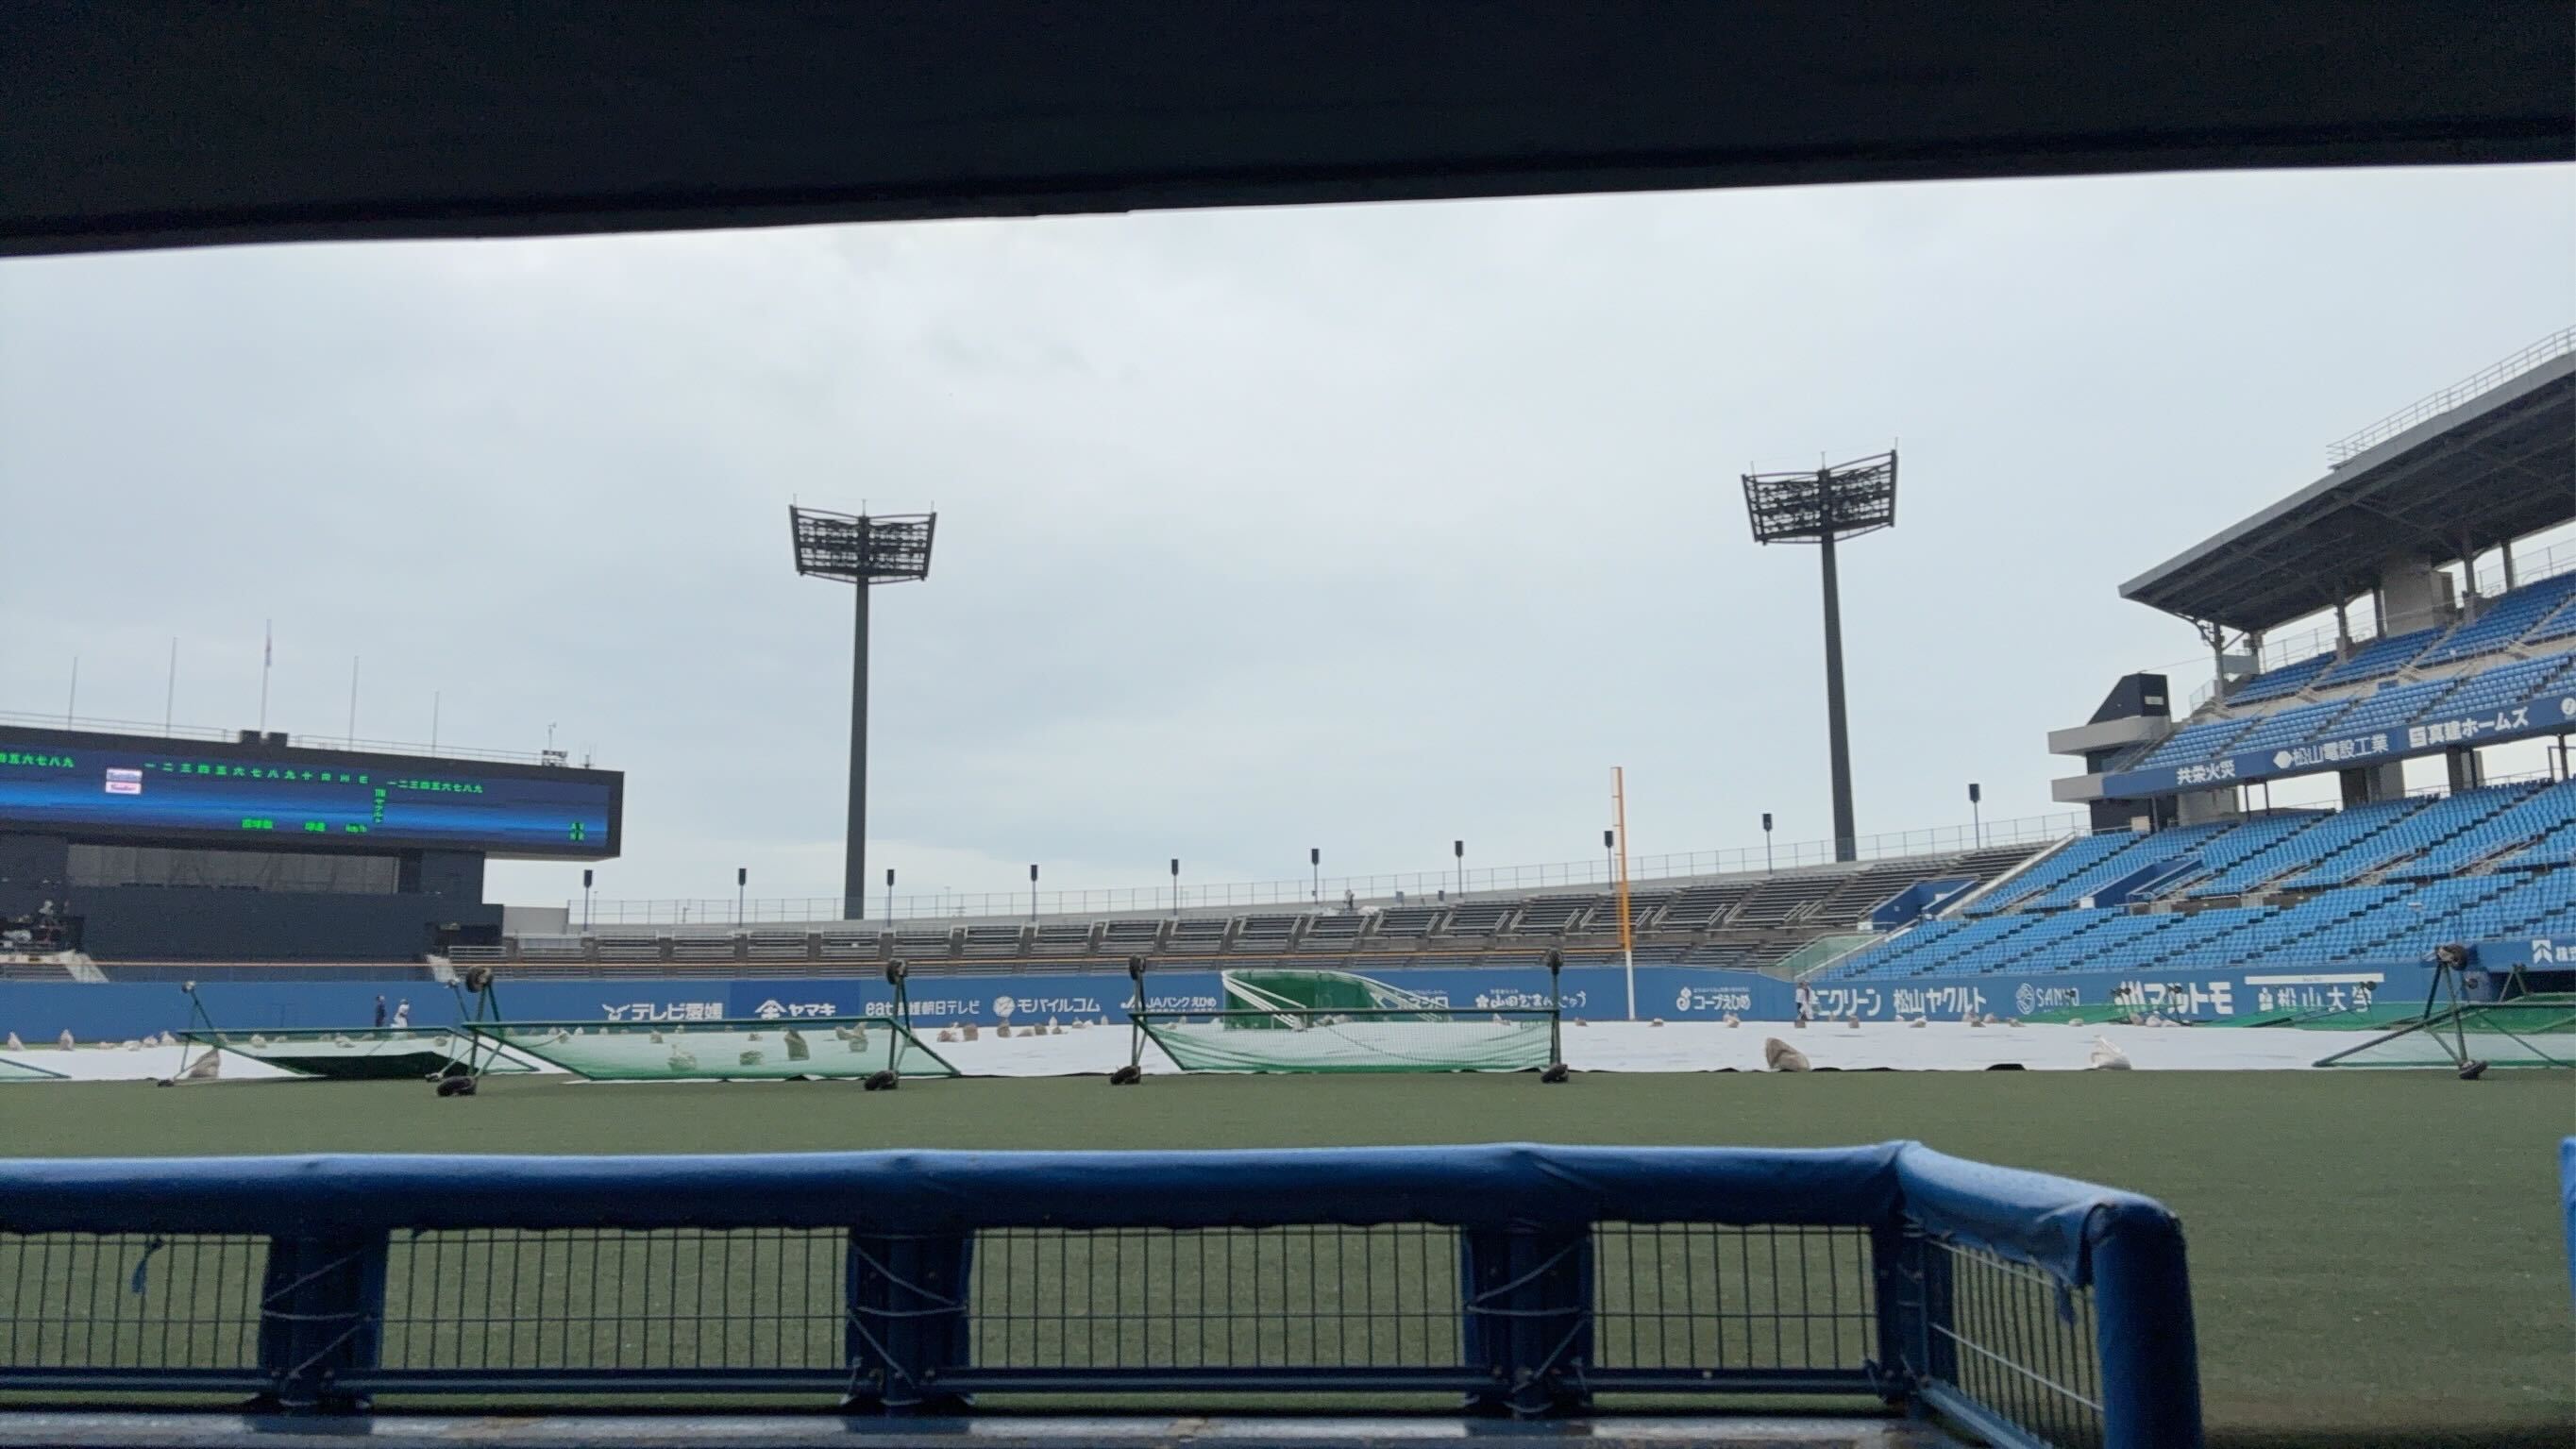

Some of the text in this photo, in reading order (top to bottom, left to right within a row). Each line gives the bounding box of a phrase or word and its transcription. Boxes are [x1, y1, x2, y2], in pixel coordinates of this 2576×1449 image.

[2293, 733, 2389, 767] 松山電設工業
[2177, 759, 2236, 786] 共栄火災
[1018, 998, 1101, 1013] モバイルコム
[1146, 996, 1189, 1008] JAバンク
[1693, 994, 1751, 1011] コープえひめ
[1894, 987, 1987, 1014] 松山ヤクルト
[2277, 986, 2372, 1012] 松山大学
[631, 1003, 723, 1020] テレビ愛媛
[788, 1003, 836, 1018] ヤマキ
[865, 1001, 893, 1017] eat
